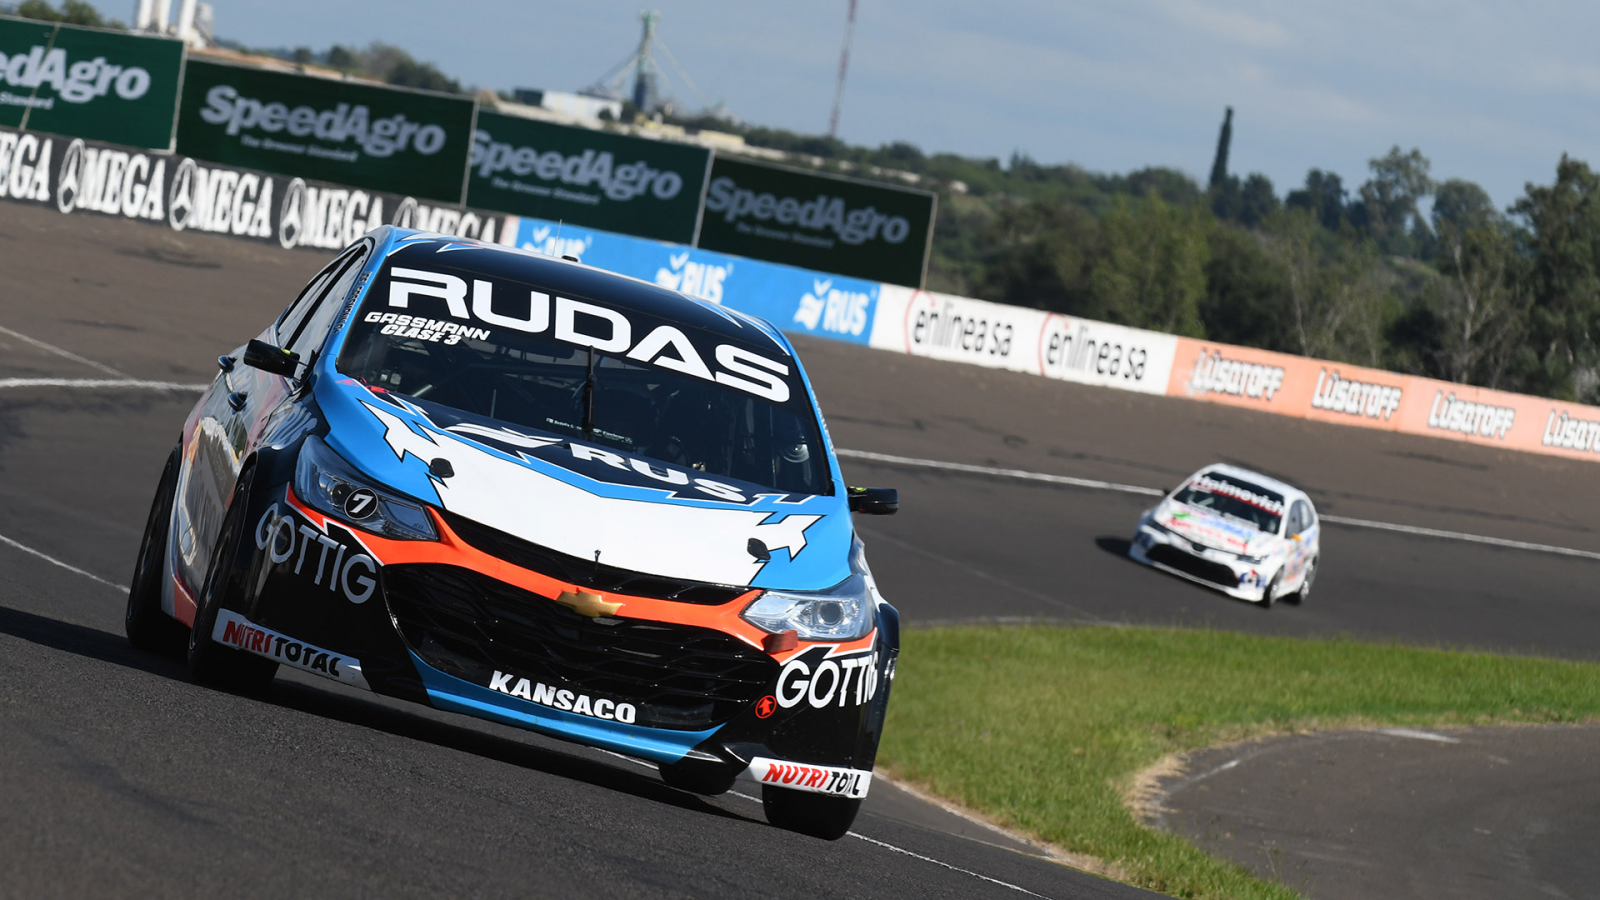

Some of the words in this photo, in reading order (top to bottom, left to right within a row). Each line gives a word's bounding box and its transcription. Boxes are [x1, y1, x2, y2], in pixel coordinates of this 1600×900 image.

[0, 45, 151, 104] dAgro
[200, 84, 447, 158] SpeedAgro
[469, 128, 683, 200] SpeedAgro
[705, 176, 910, 245] SpeedAgro
[679, 262, 728, 304] RUS
[364, 312, 491, 341] GASSMANN
[380, 325, 445, 344] CLASE
[443, 333, 463, 346] 3
[389, 267, 790, 402] RUDAS
[822, 289, 870, 336] RUS
[913, 303, 987, 353] enlinea
[989, 322, 1014, 357] sa
[1046, 325, 1122, 376] enlinea
[1124, 343, 1148, 381] sa
[570, 443, 747, 502] RUS
[350, 494, 374, 513] 7
[255, 503, 377, 604] GOTTIG
[488, 670, 637, 725] KANSACO
[775, 652, 879, 709] GOTTIG
